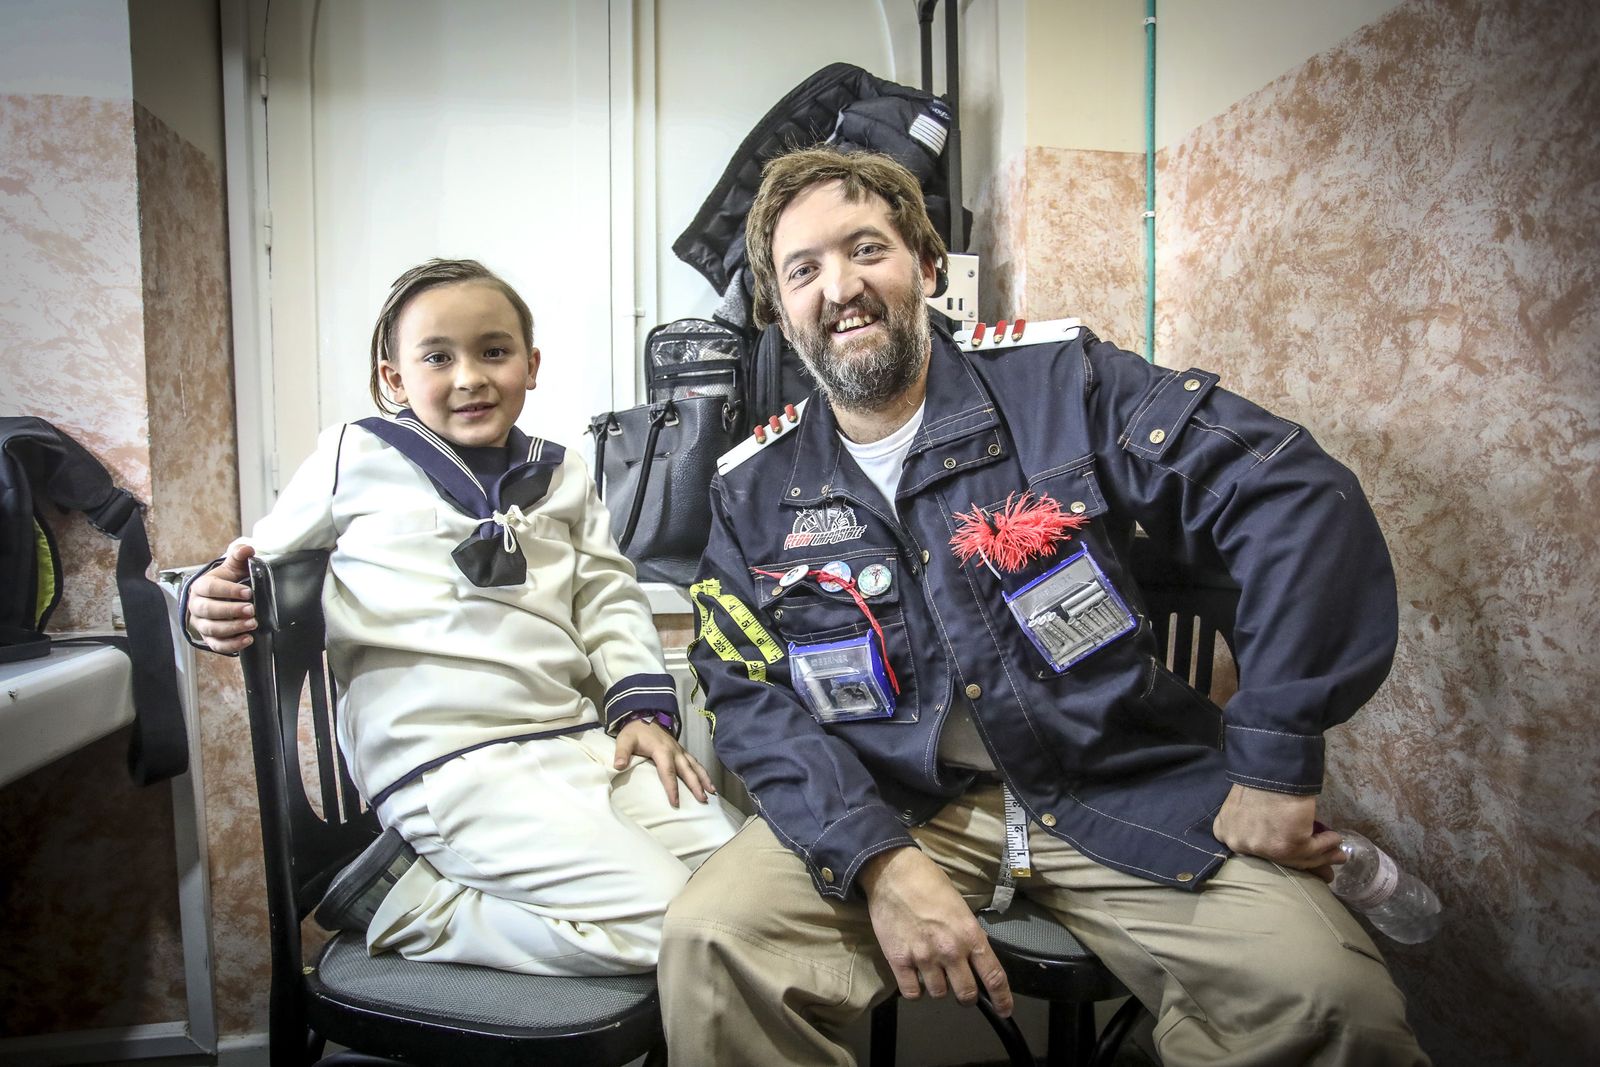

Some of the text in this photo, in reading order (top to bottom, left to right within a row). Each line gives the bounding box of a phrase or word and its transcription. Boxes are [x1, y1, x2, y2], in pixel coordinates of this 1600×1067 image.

[713, 639, 727, 653] 23
[741, 619, 750, 628] 5
[756, 637, 765, 645] 6
[769, 654, 779, 662] 7
[1014, 825, 1023, 833] 2
